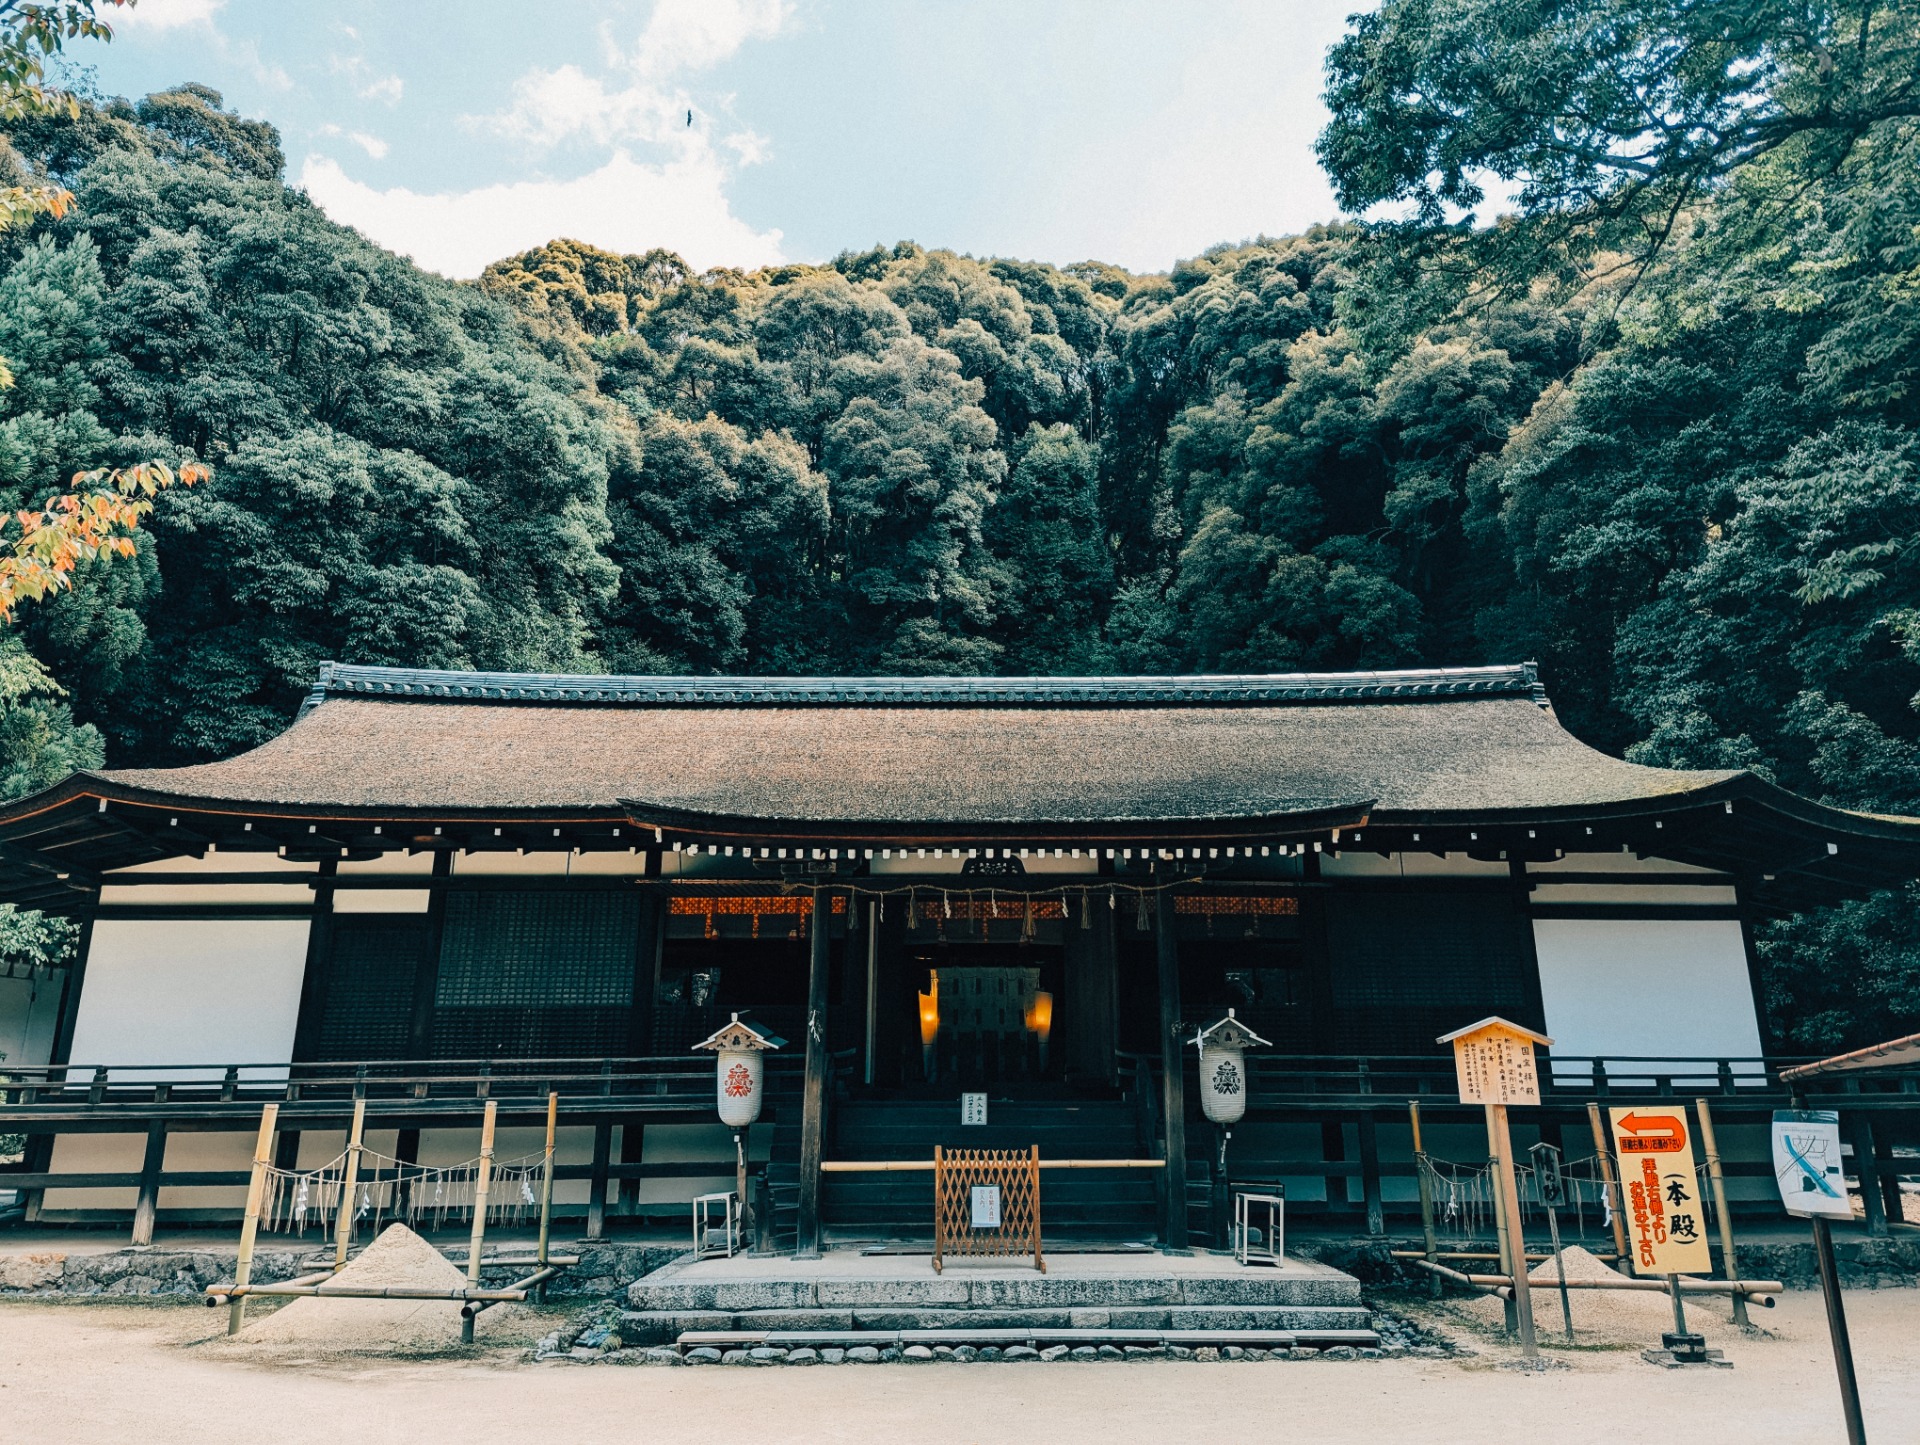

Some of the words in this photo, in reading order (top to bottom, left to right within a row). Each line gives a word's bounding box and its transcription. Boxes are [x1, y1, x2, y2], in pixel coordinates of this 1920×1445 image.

[1621, 1138, 1682, 1150] 拝殿右側よりお進み下さい
[1629, 1180, 1656, 1267] お進み下さい
[1641, 1158, 1667, 1244] 拝殿右側より
